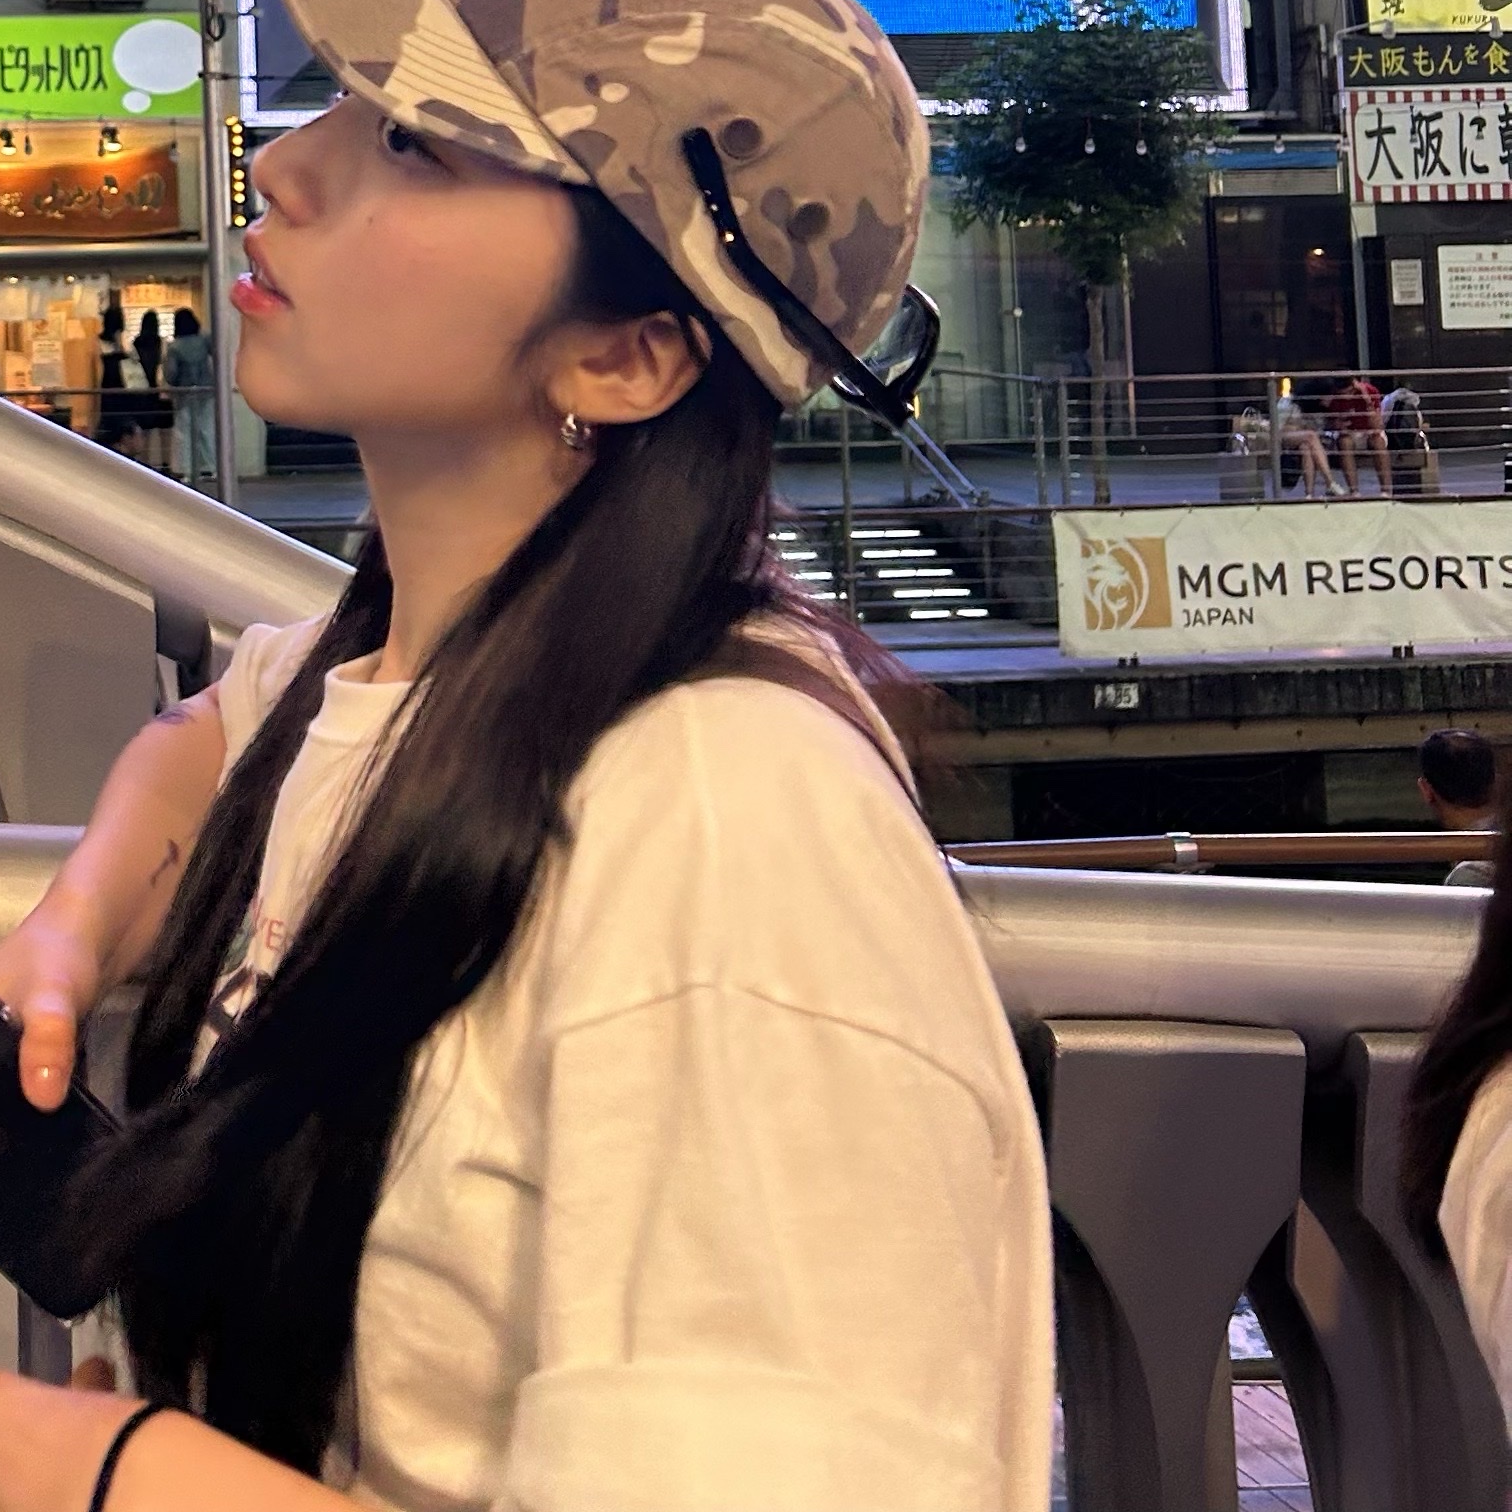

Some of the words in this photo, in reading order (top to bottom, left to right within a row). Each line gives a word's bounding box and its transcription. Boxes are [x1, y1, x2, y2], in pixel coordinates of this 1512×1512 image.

[0, 44, 109, 93] ピタットハウス
[1349, 41, 1512, 79] 大阪もんを食
[1178, 562, 1287, 600] MGM
[1182, 606, 1255, 628] JAPAN
